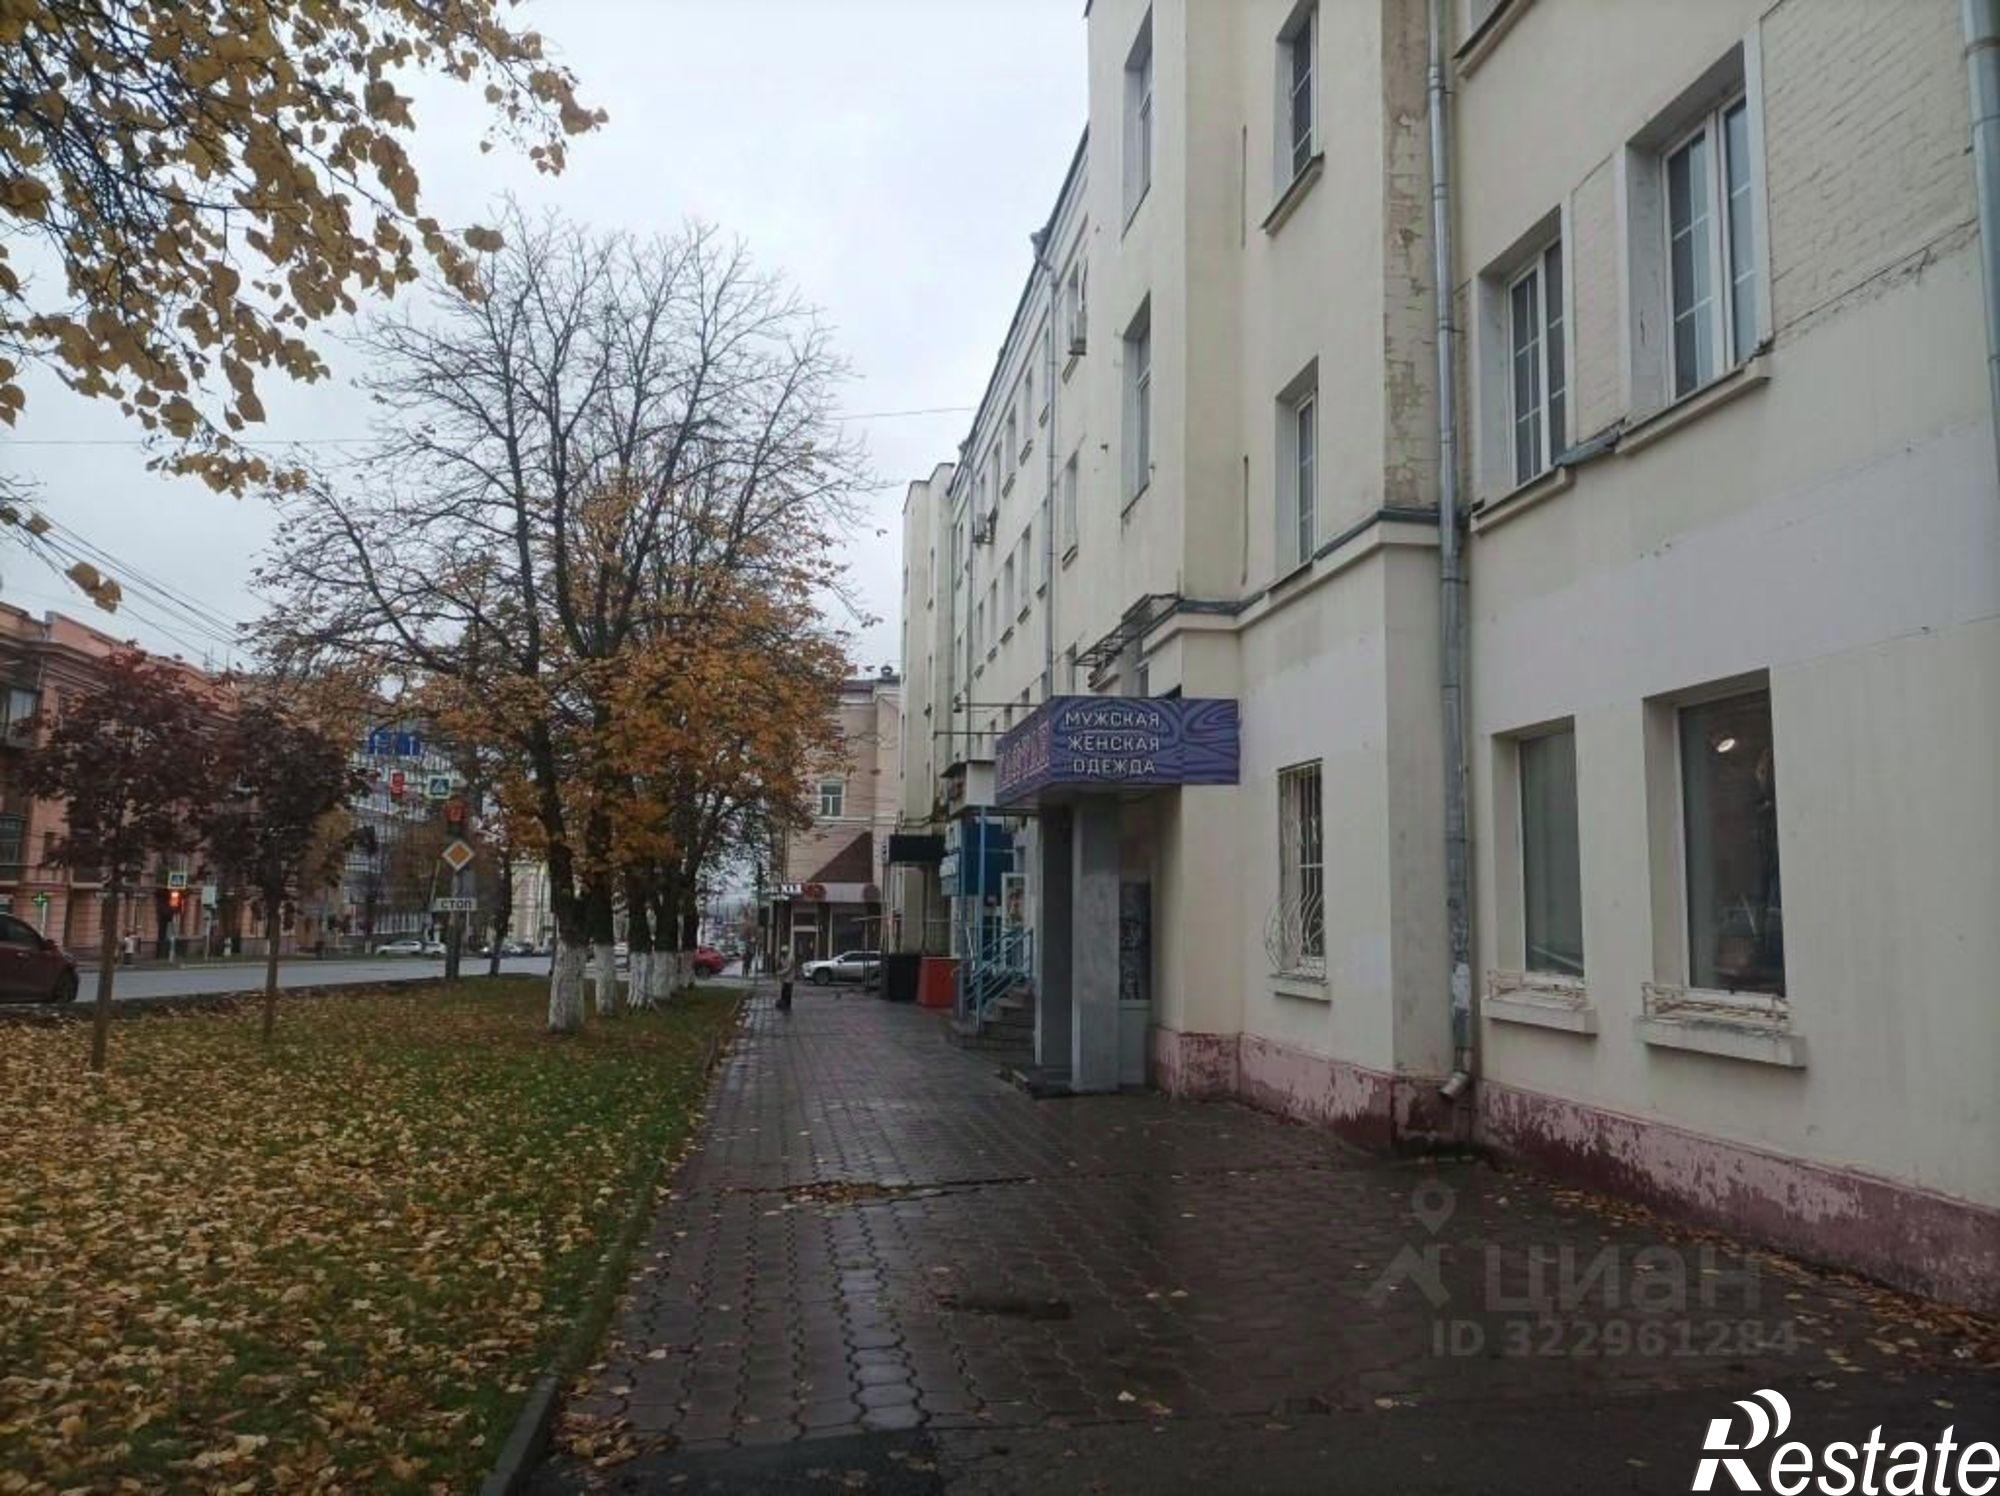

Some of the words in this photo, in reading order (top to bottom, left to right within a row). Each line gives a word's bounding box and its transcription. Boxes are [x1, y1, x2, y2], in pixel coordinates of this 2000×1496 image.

[1065, 711, 1160, 728] МУЖСКАЯ
[1067, 735, 1160, 752] ЖЕНСКАЯ
[1073, 758, 1157, 776] ОДЕЖДА
